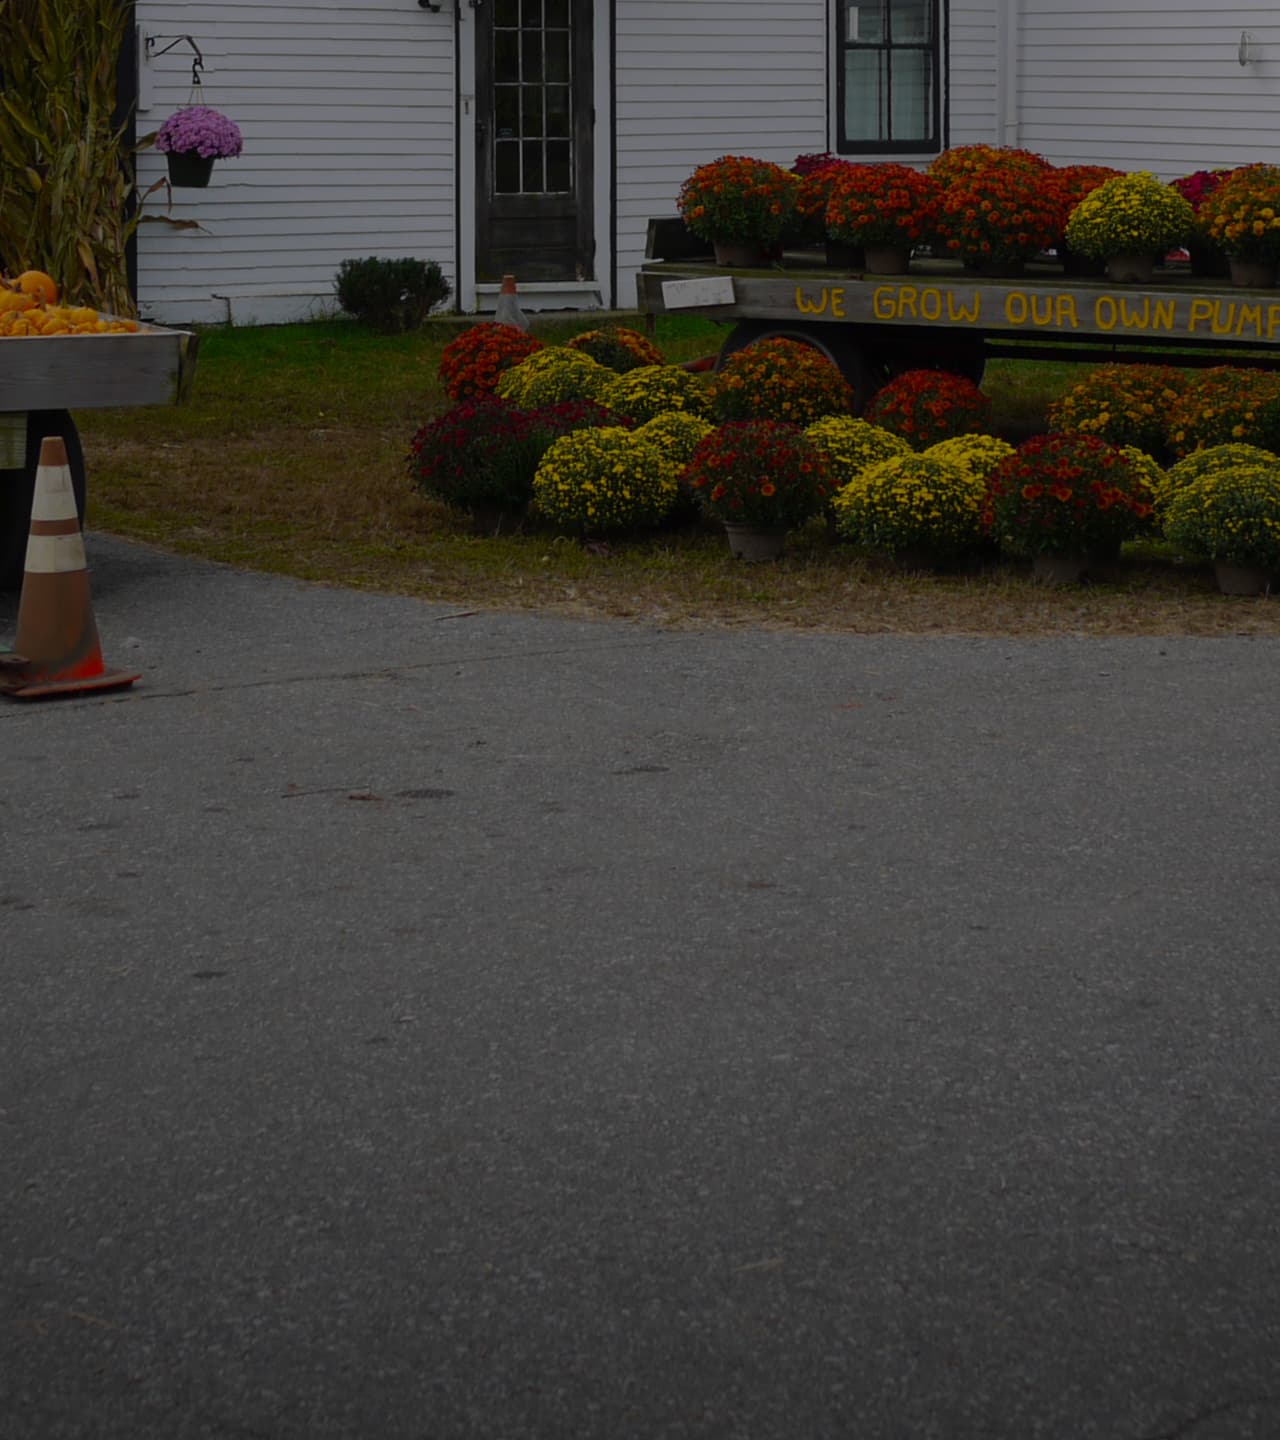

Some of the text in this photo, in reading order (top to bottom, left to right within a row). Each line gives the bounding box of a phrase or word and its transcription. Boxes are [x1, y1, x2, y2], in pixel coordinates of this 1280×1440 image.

[795, 287, 846, 318] WE
[872, 285, 981, 322] GROW
[1005, 293, 1078, 328] OUR
[1095, 295, 1176, 331] OWN
